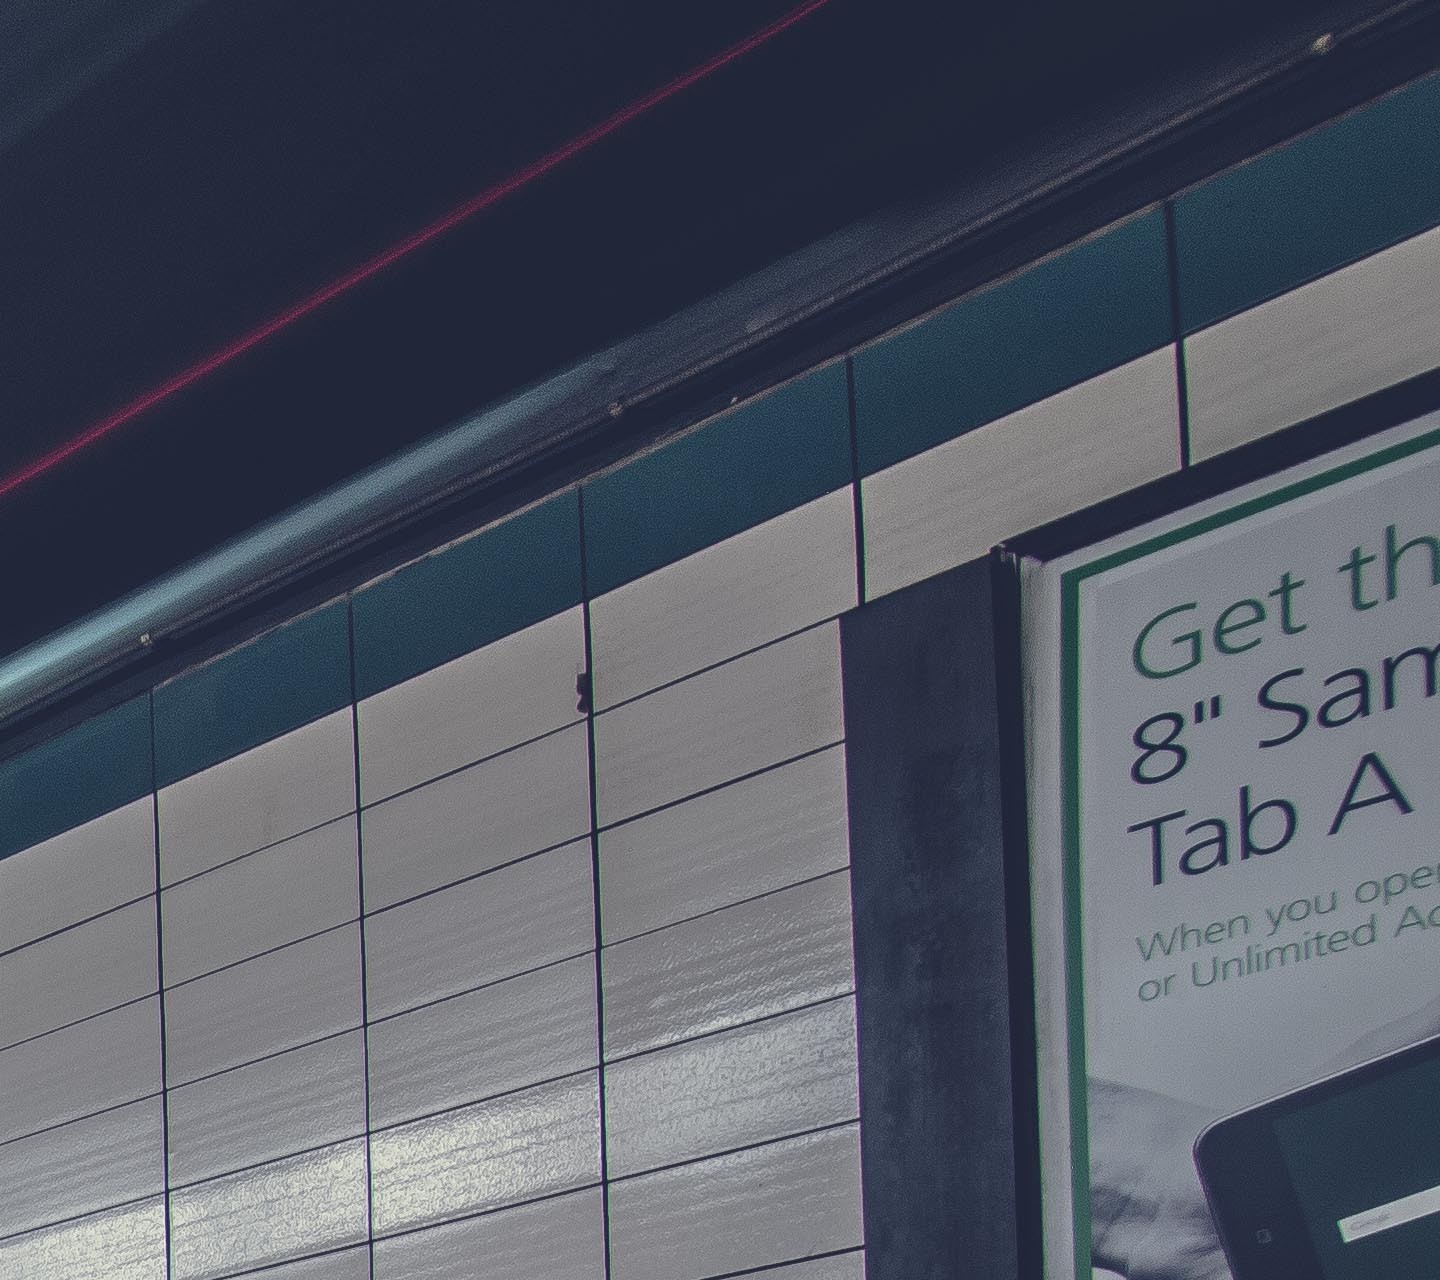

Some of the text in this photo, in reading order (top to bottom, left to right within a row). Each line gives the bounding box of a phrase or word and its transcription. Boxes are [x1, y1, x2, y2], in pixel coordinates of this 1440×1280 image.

[1133, 523, 1440, 679] Get th
[1130, 694, 1221, 785] 8"
[1126, 751, 1416, 886] Tab A
[1135, 862, 1440, 962] When you ope
[1138, 973, 1177, 1002] or
[1191, 913, 1378, 988] Unlimited
